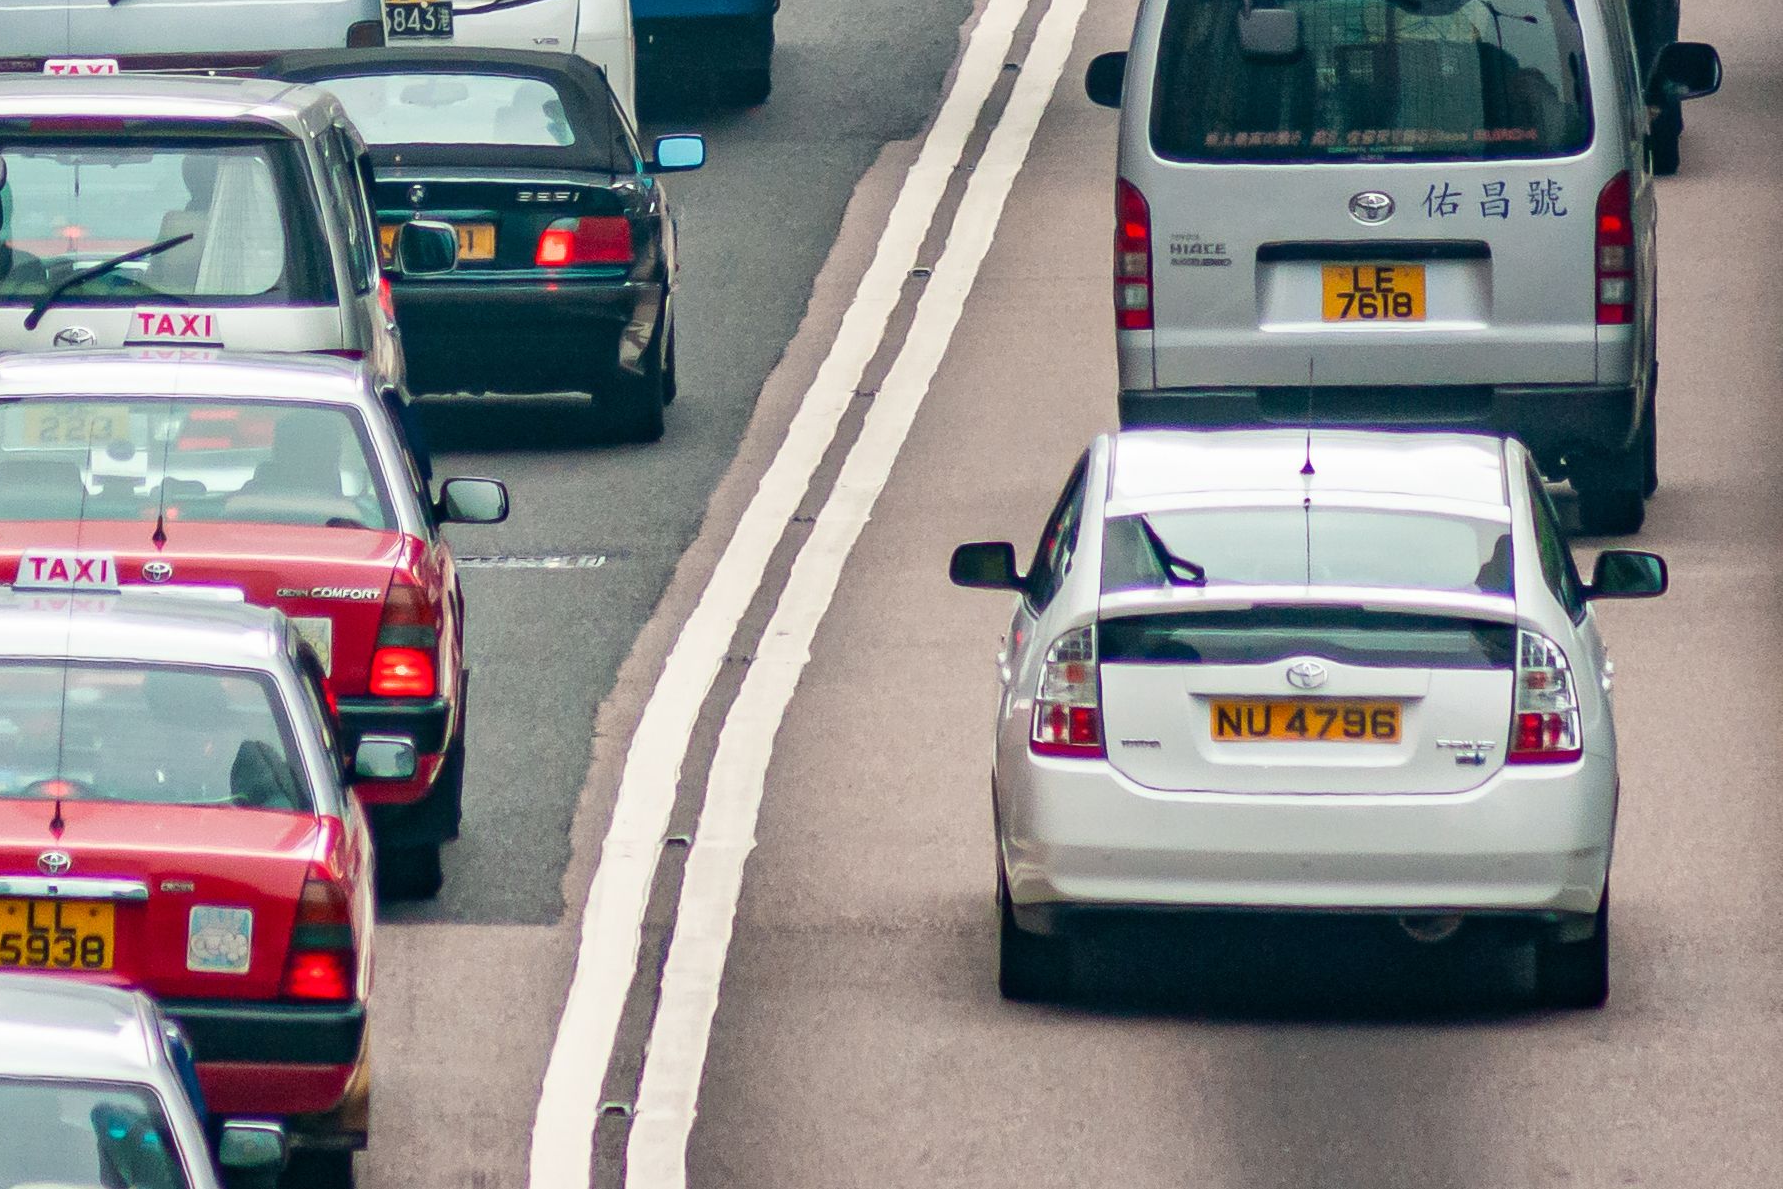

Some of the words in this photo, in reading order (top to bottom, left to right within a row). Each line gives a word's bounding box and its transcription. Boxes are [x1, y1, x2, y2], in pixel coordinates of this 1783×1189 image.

[1421, 178, 1568, 220] 佑昌號
[1169, 242, 1227, 255] HIACE
[1353, 267, 1395, 293] LE
[1336, 292, 1414, 319] 7618
[138, 313, 212, 338] TAXI
[28, 556, 108, 584] TAXI
[310, 587, 381, 600] COMFORT
[1217, 705, 1271, 737] NU
[1285, 705, 1398, 740] 4796
[27, 901, 77, 933] LL
